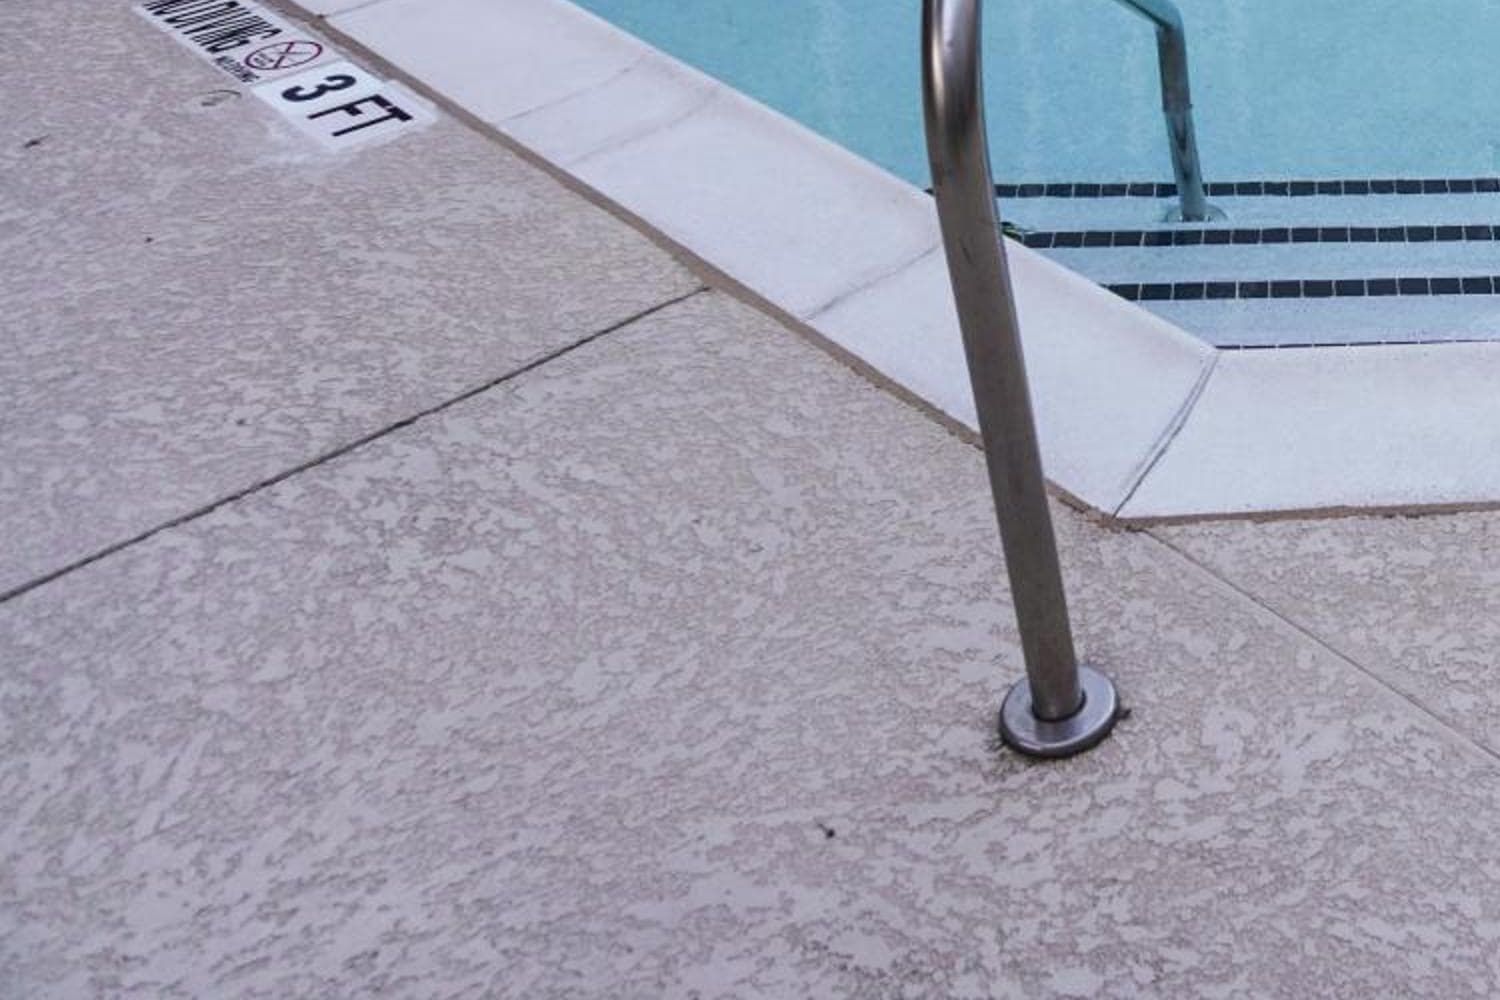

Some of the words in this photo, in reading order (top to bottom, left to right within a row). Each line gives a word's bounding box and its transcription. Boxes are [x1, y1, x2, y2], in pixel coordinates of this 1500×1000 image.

[163, 0, 283, 53] DIVING
[281, 74, 357, 103] 3
[306, 93, 414, 138] FT
